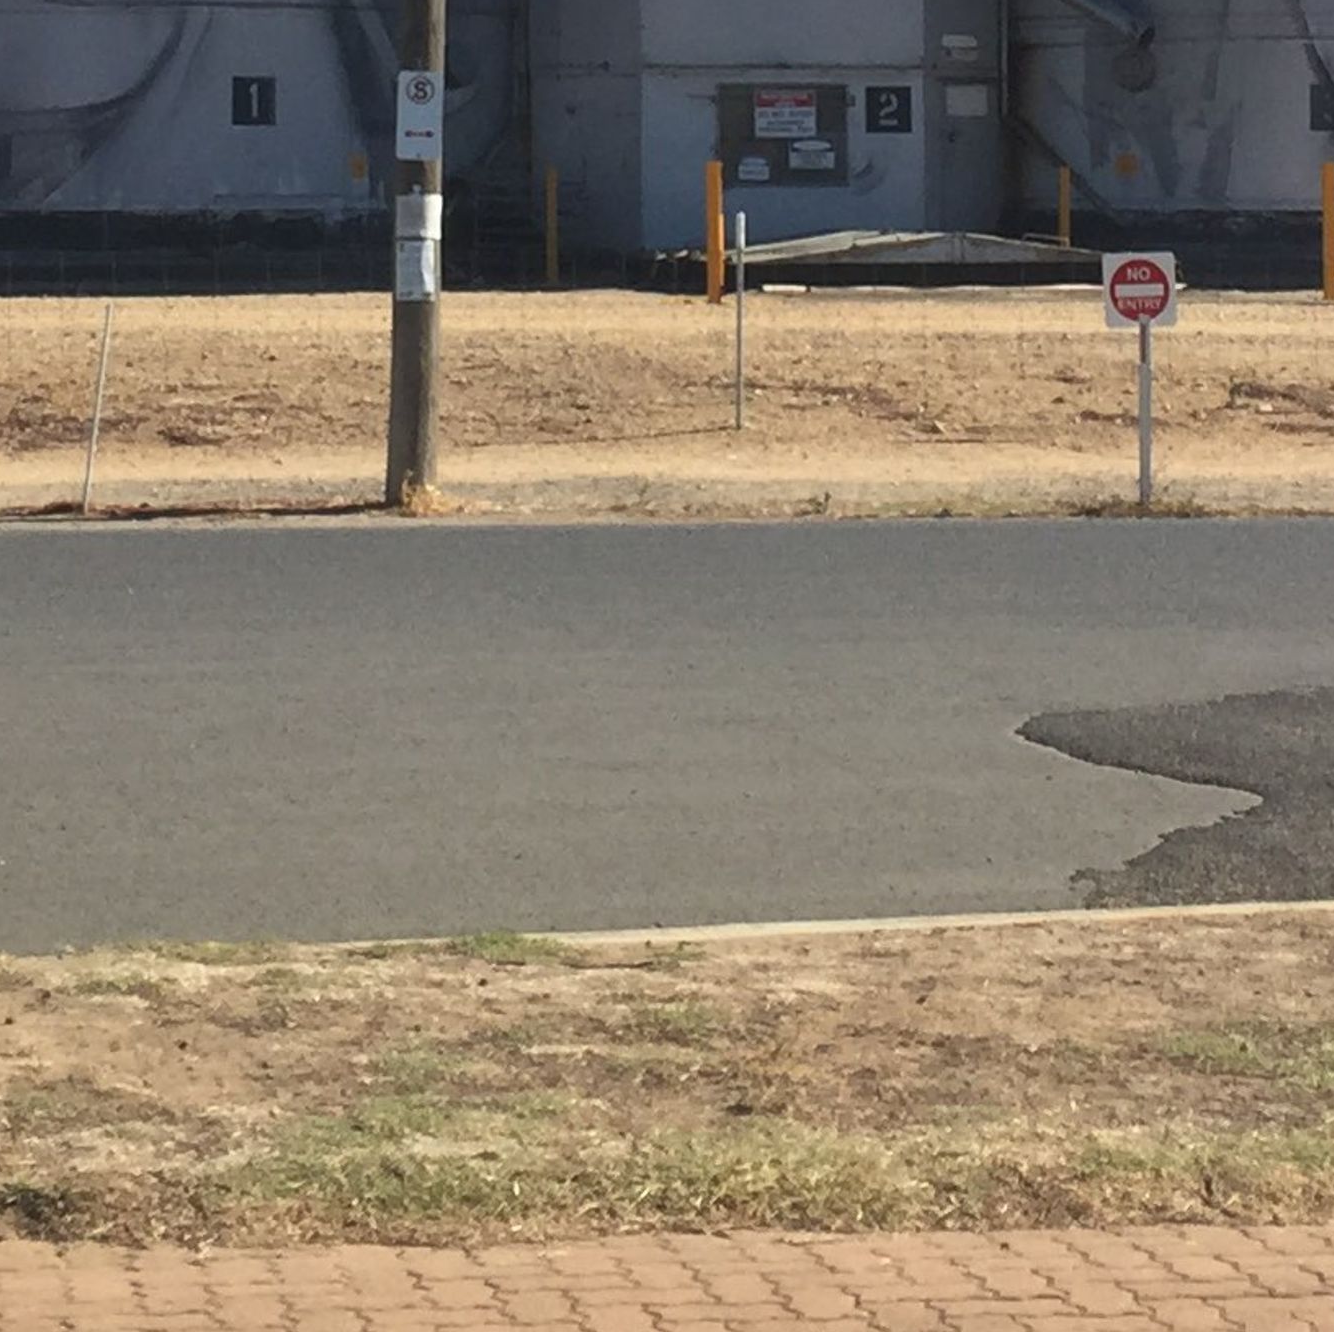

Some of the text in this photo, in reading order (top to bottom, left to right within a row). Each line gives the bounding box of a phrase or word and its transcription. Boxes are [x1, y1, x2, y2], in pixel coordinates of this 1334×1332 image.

[249, 82, 260, 118] 1
[878, 92, 899, 125] 2
[1126, 267, 1151, 281] NO
[1117, 298, 1162, 310] ENTRY
